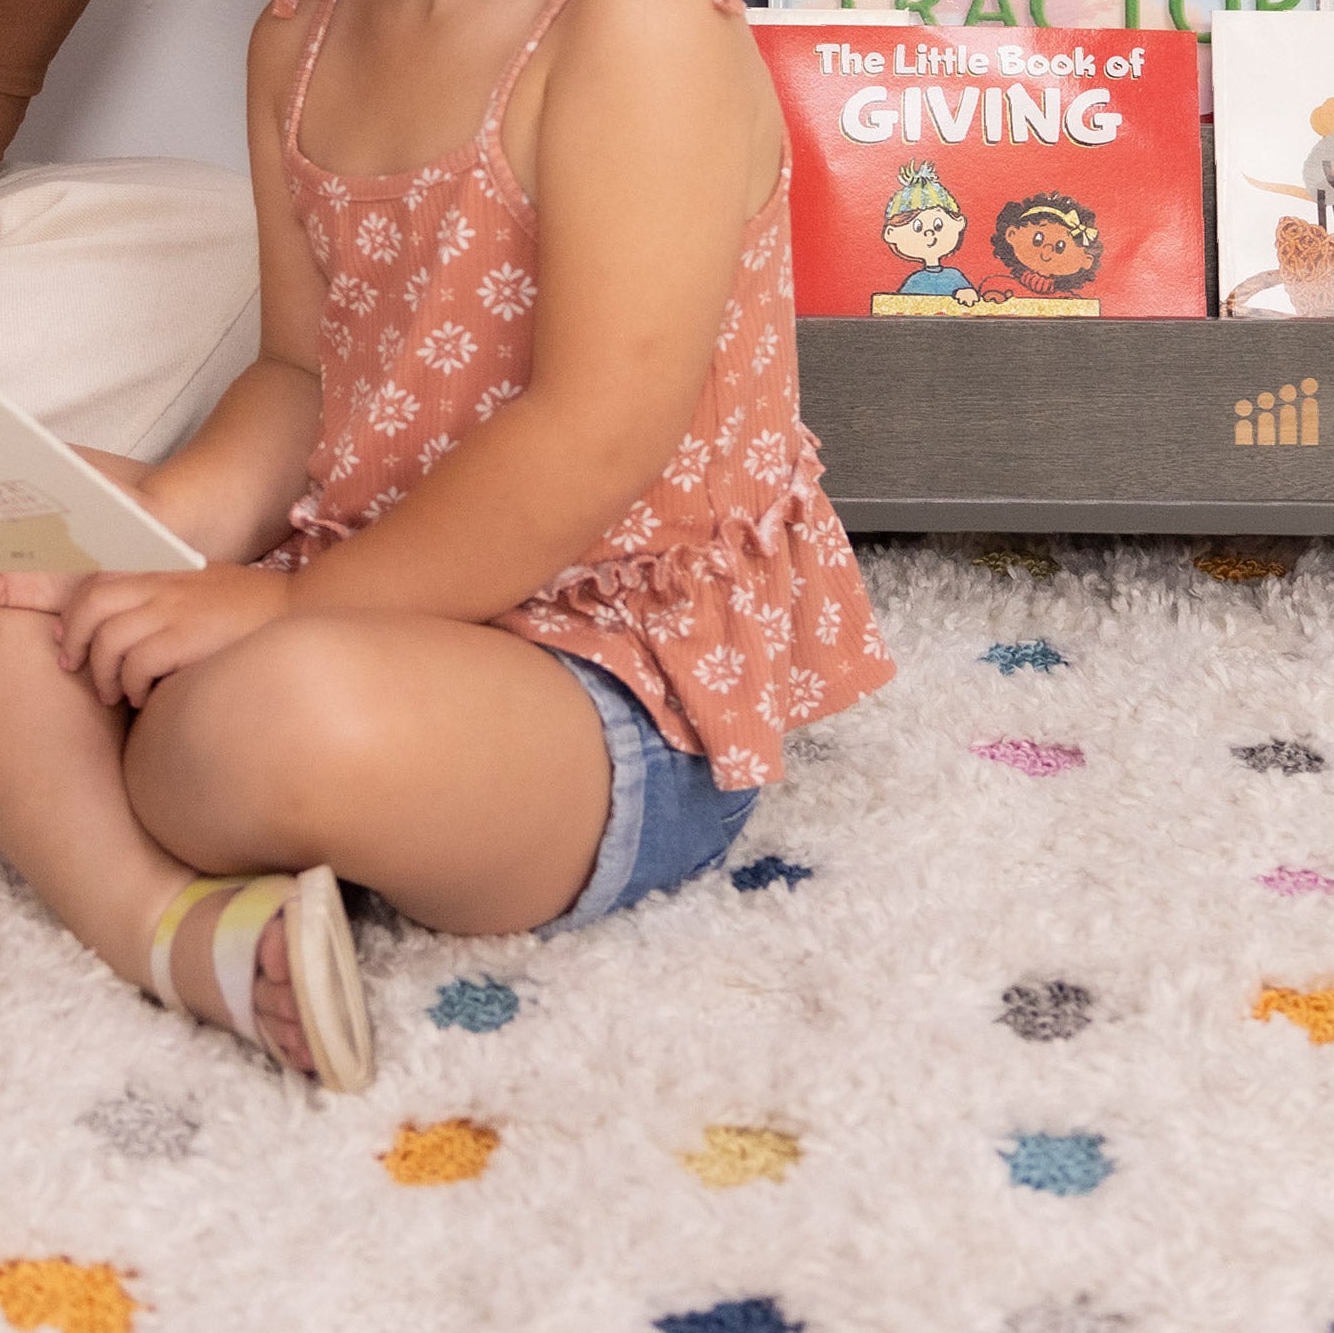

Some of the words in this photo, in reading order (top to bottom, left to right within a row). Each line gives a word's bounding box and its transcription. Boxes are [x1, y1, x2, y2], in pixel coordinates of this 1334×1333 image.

[814, 43, 885, 77] The
[893, 43, 990, 78] Little
[997, 44, 1096, 80] Book
[1103, 46, 1146, 80] of
[837, 82, 1124, 148] GIVING
